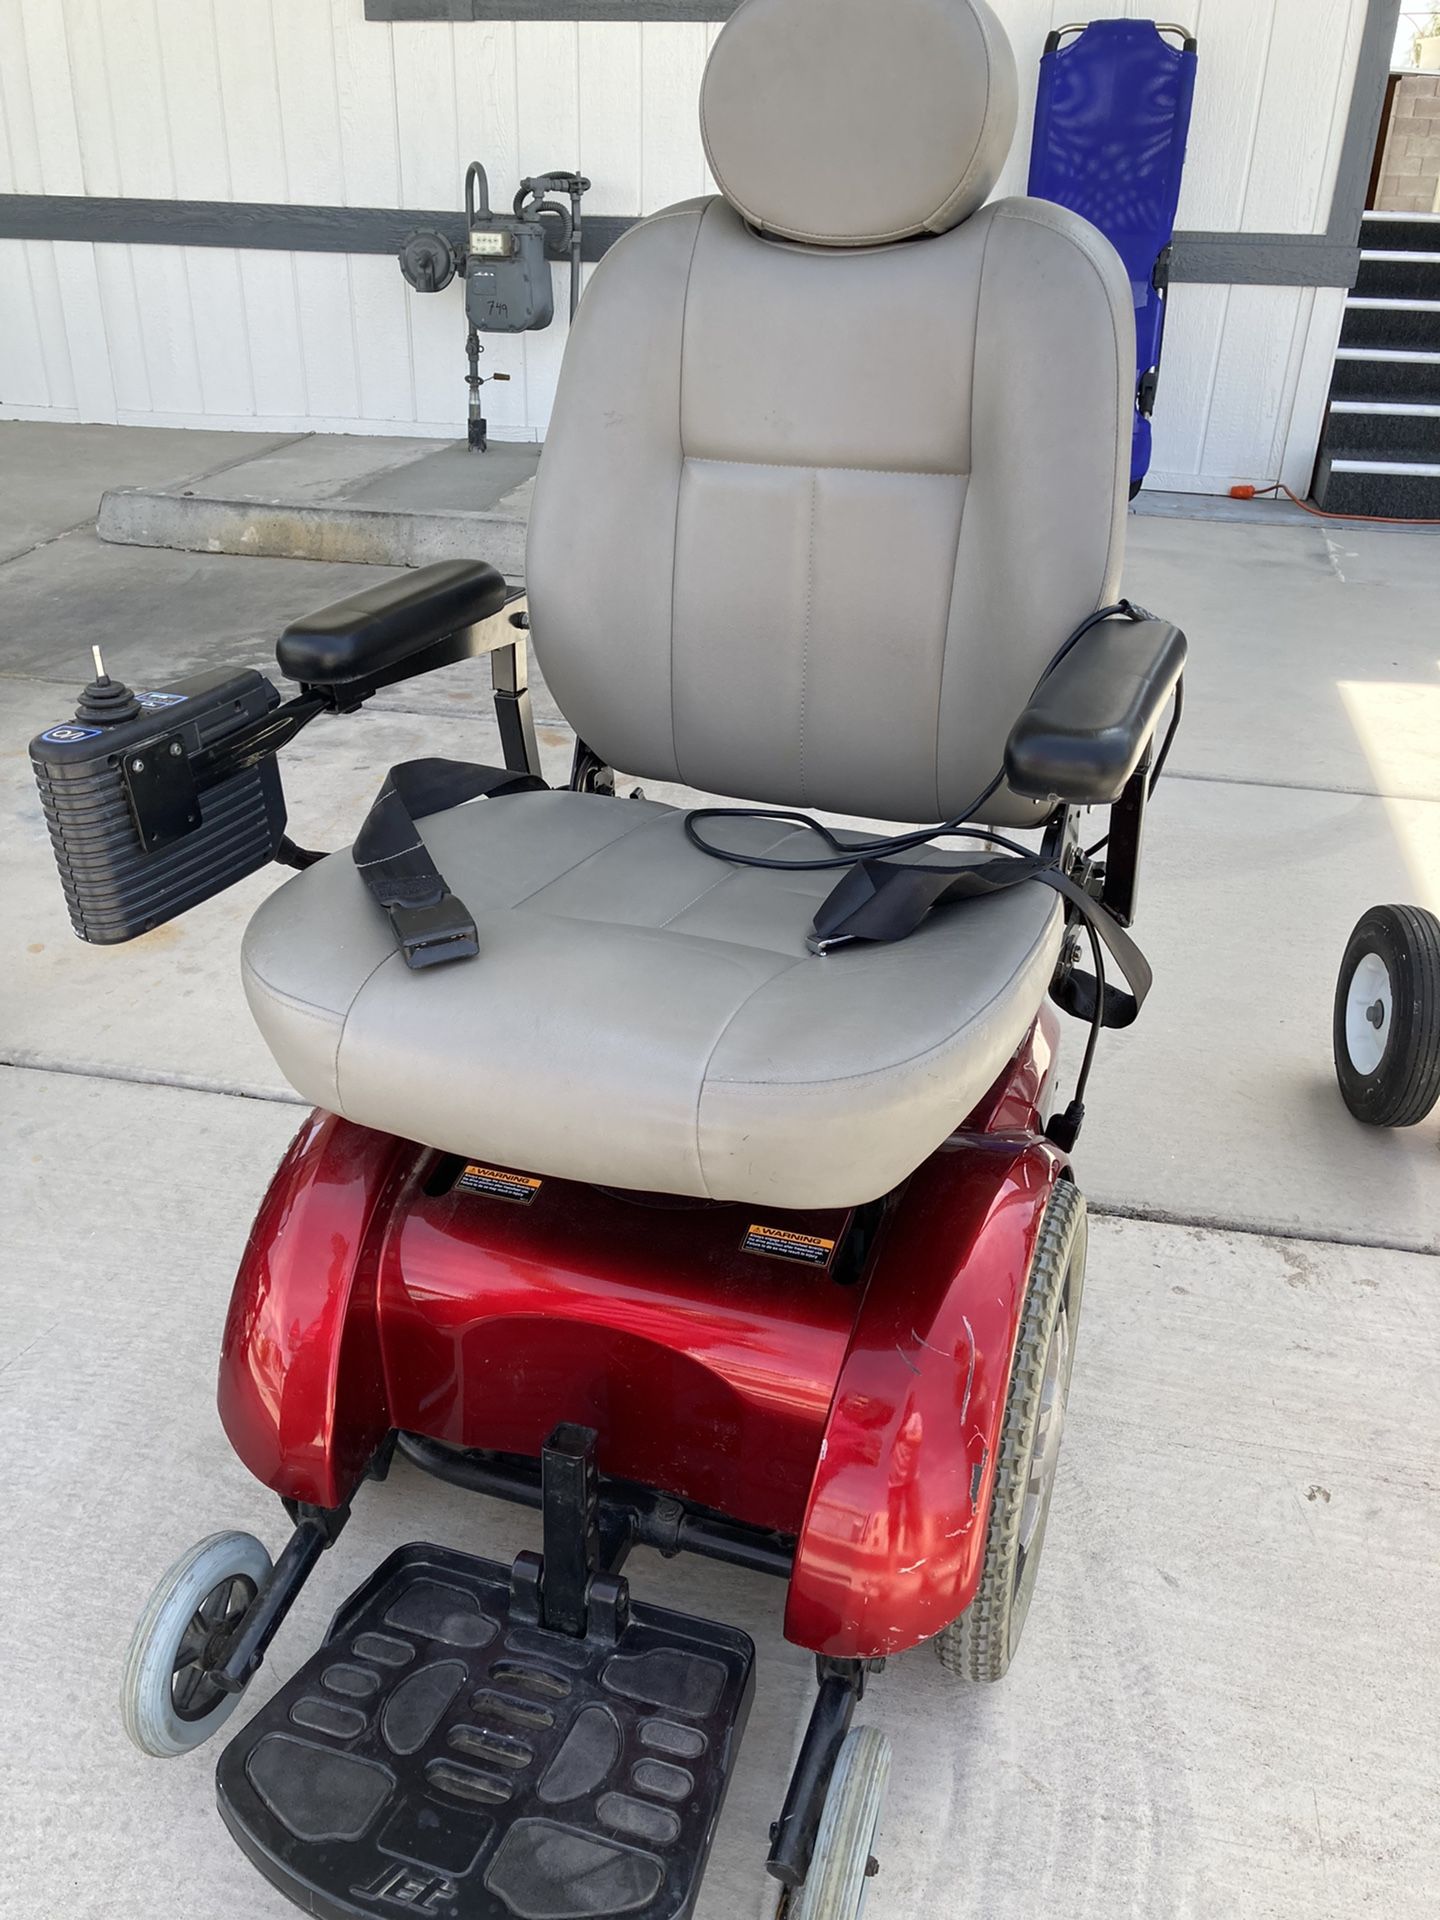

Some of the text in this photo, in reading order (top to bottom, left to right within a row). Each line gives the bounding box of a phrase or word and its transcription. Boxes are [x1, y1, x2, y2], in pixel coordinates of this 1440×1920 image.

[487, 301, 508, 318] 749
[477, 1168, 530, 1184] WARNING
[762, 1228, 822, 1244] WARNING
